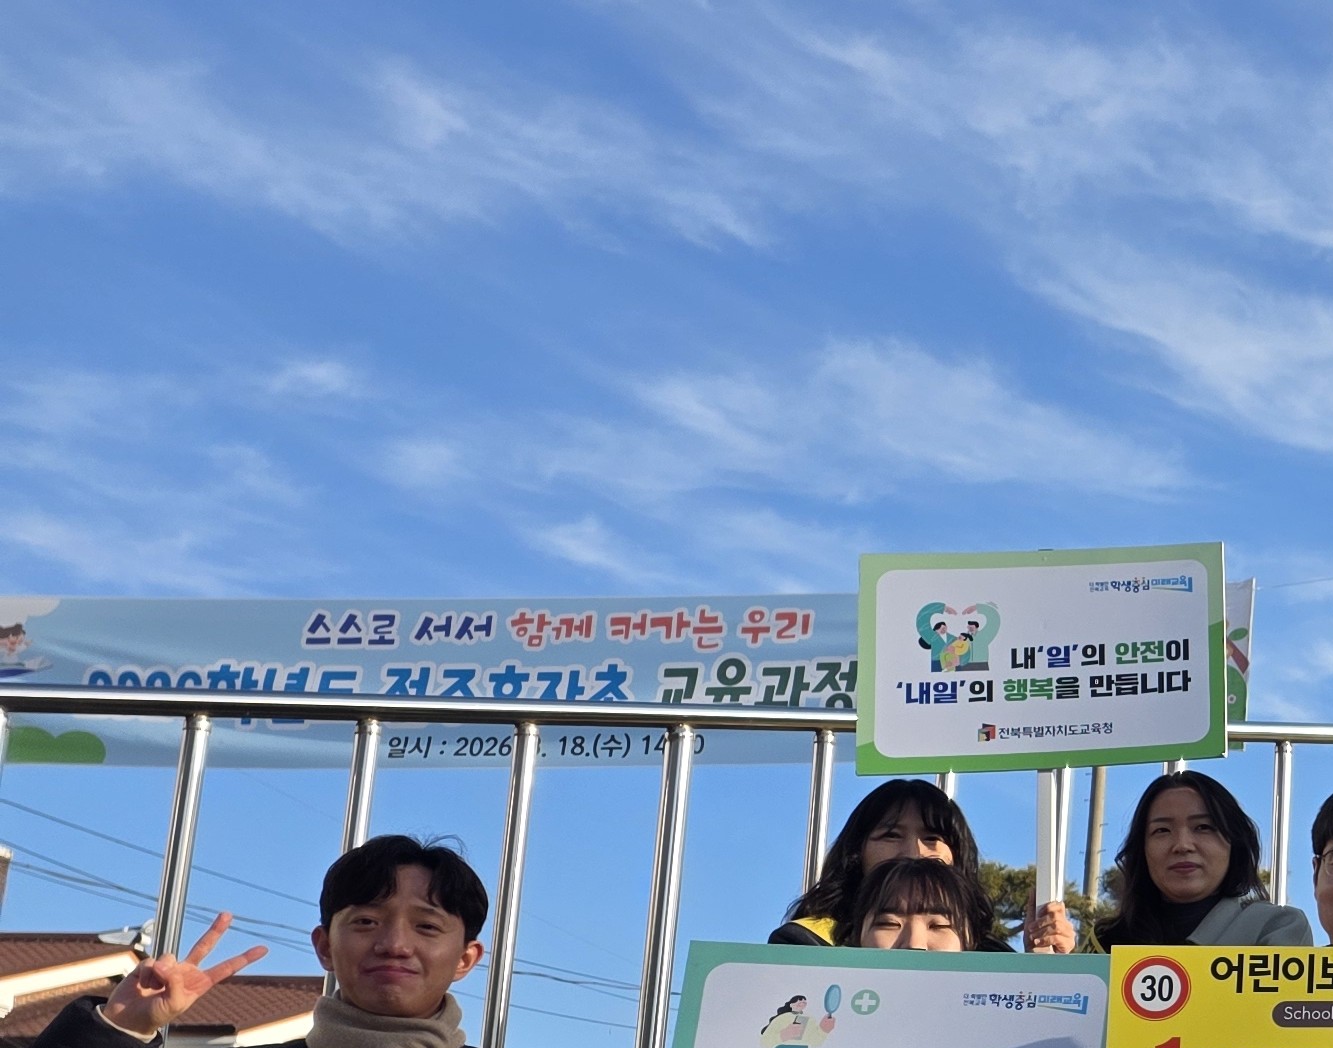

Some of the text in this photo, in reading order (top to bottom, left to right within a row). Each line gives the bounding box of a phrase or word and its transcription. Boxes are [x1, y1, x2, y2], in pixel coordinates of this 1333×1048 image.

[305, 609, 810, 649] 스스로 서서 함께 커가는 우리
[1114, 638, 1190, 665] 안전이
[1003, 675, 1080, 702] 행복을
[1089, 669, 1192, 699] 만듭니다
[998, 721, 1114, 740] 전북특별자치도교육청
[388, 737, 433, 758] 일시
[559, 733, 631, 758] 18.(수)
[1140, 974, 1174, 1002] 30
